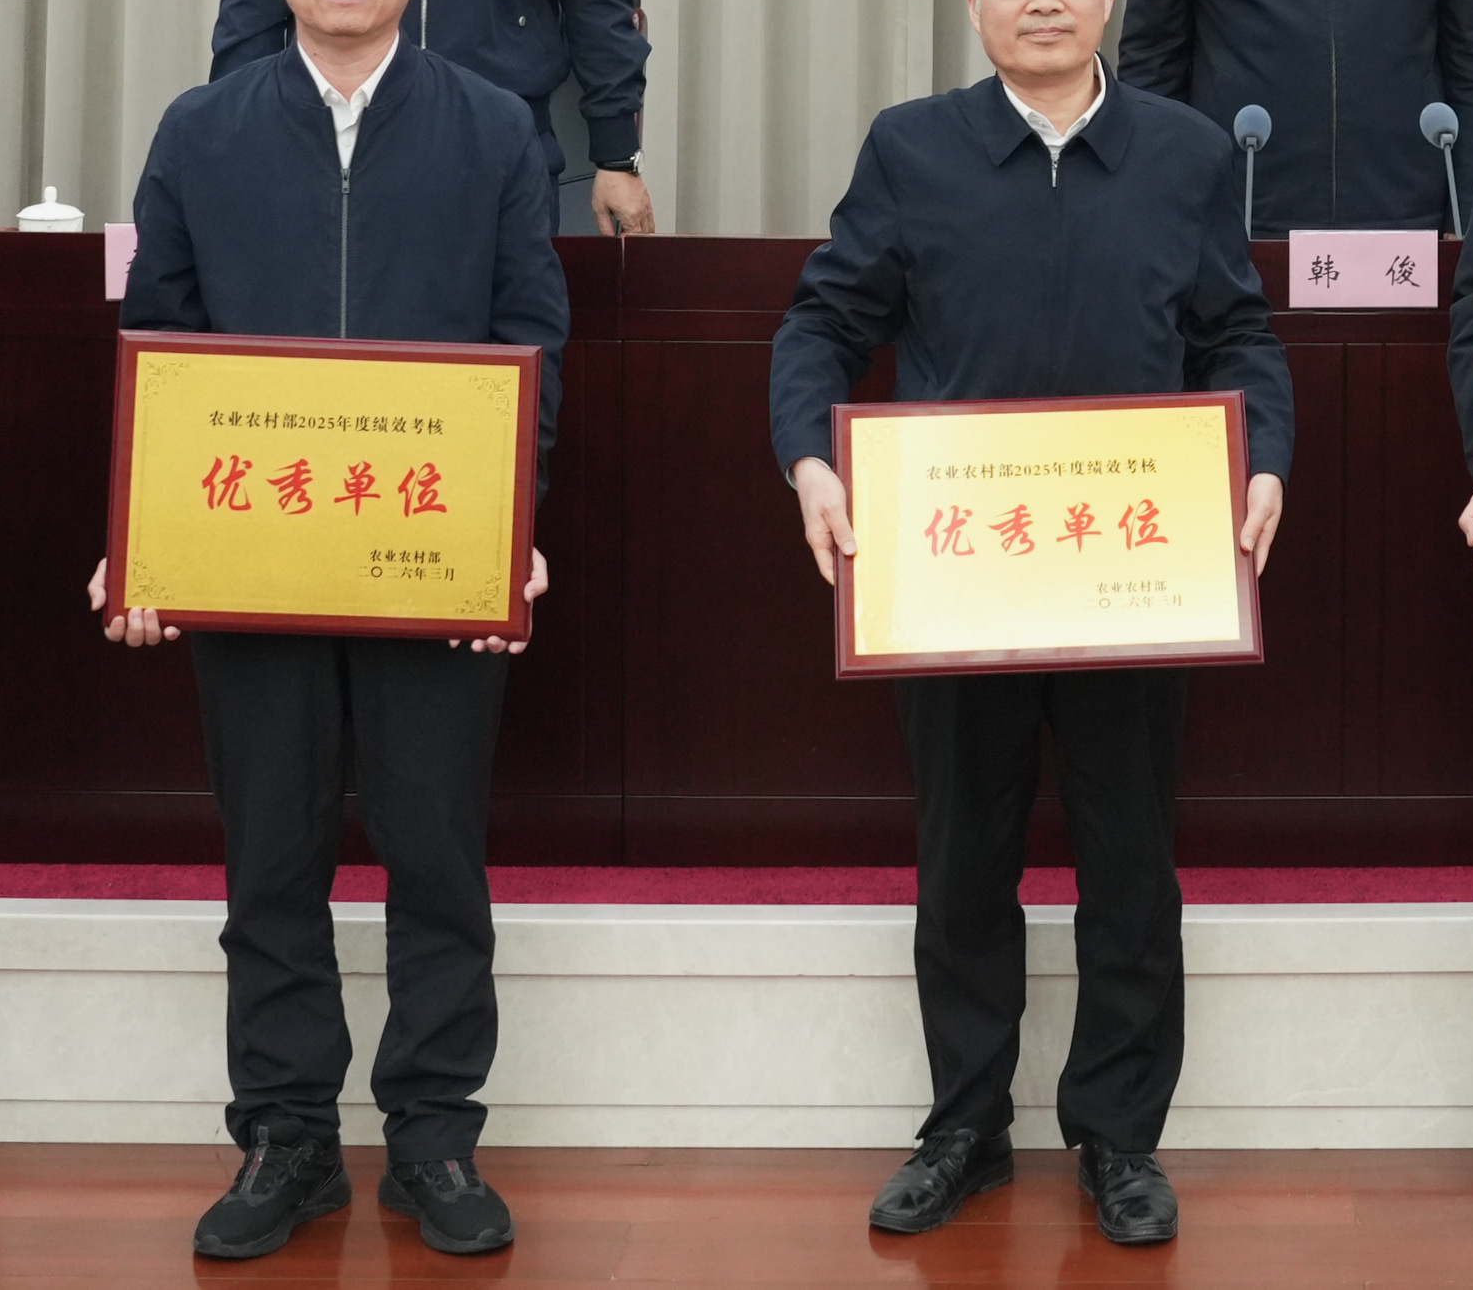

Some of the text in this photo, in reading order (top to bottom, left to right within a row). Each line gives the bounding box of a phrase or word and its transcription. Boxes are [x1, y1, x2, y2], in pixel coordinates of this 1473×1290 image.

[1308, 254, 1420, 288] 韩俊
[209, 410, 444, 435] 农业农村部2025年度绩效考核
[927, 458, 1157, 480] 农业农村部2025年度绩效考核
[202, 455, 447, 518] 优秀单位
[924, 499, 1168, 557] 优秀单位
[370, 549, 441, 564] 农业农村部
[357, 566, 455, 581] 二〇二六年三月
[1096, 580, 1167, 594] 农业农村部
